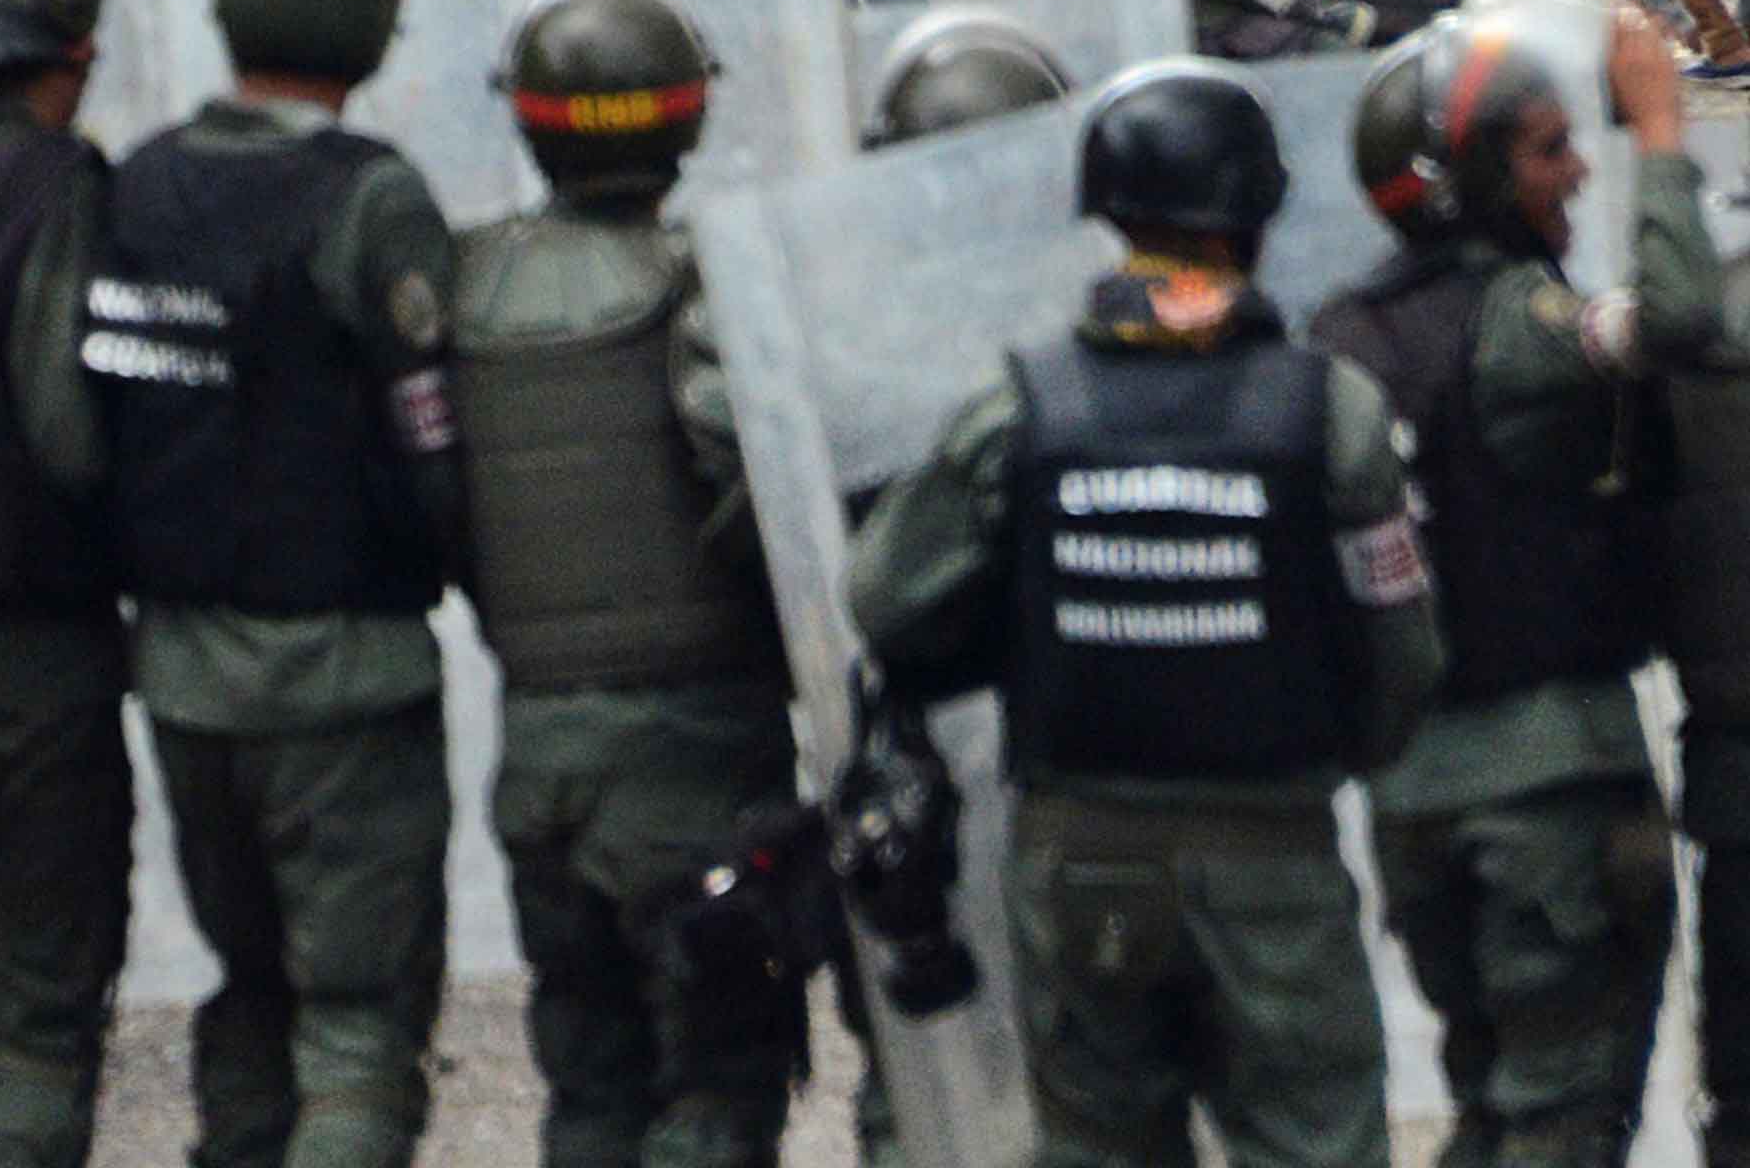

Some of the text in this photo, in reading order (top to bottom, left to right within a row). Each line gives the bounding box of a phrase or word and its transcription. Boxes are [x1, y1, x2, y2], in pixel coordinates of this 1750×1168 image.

[1059, 465, 1269, 519] GUARDIA
[1053, 531, 1262, 580] NACIONAL
[1055, 598, 1268, 647] BOLIVARIANA
